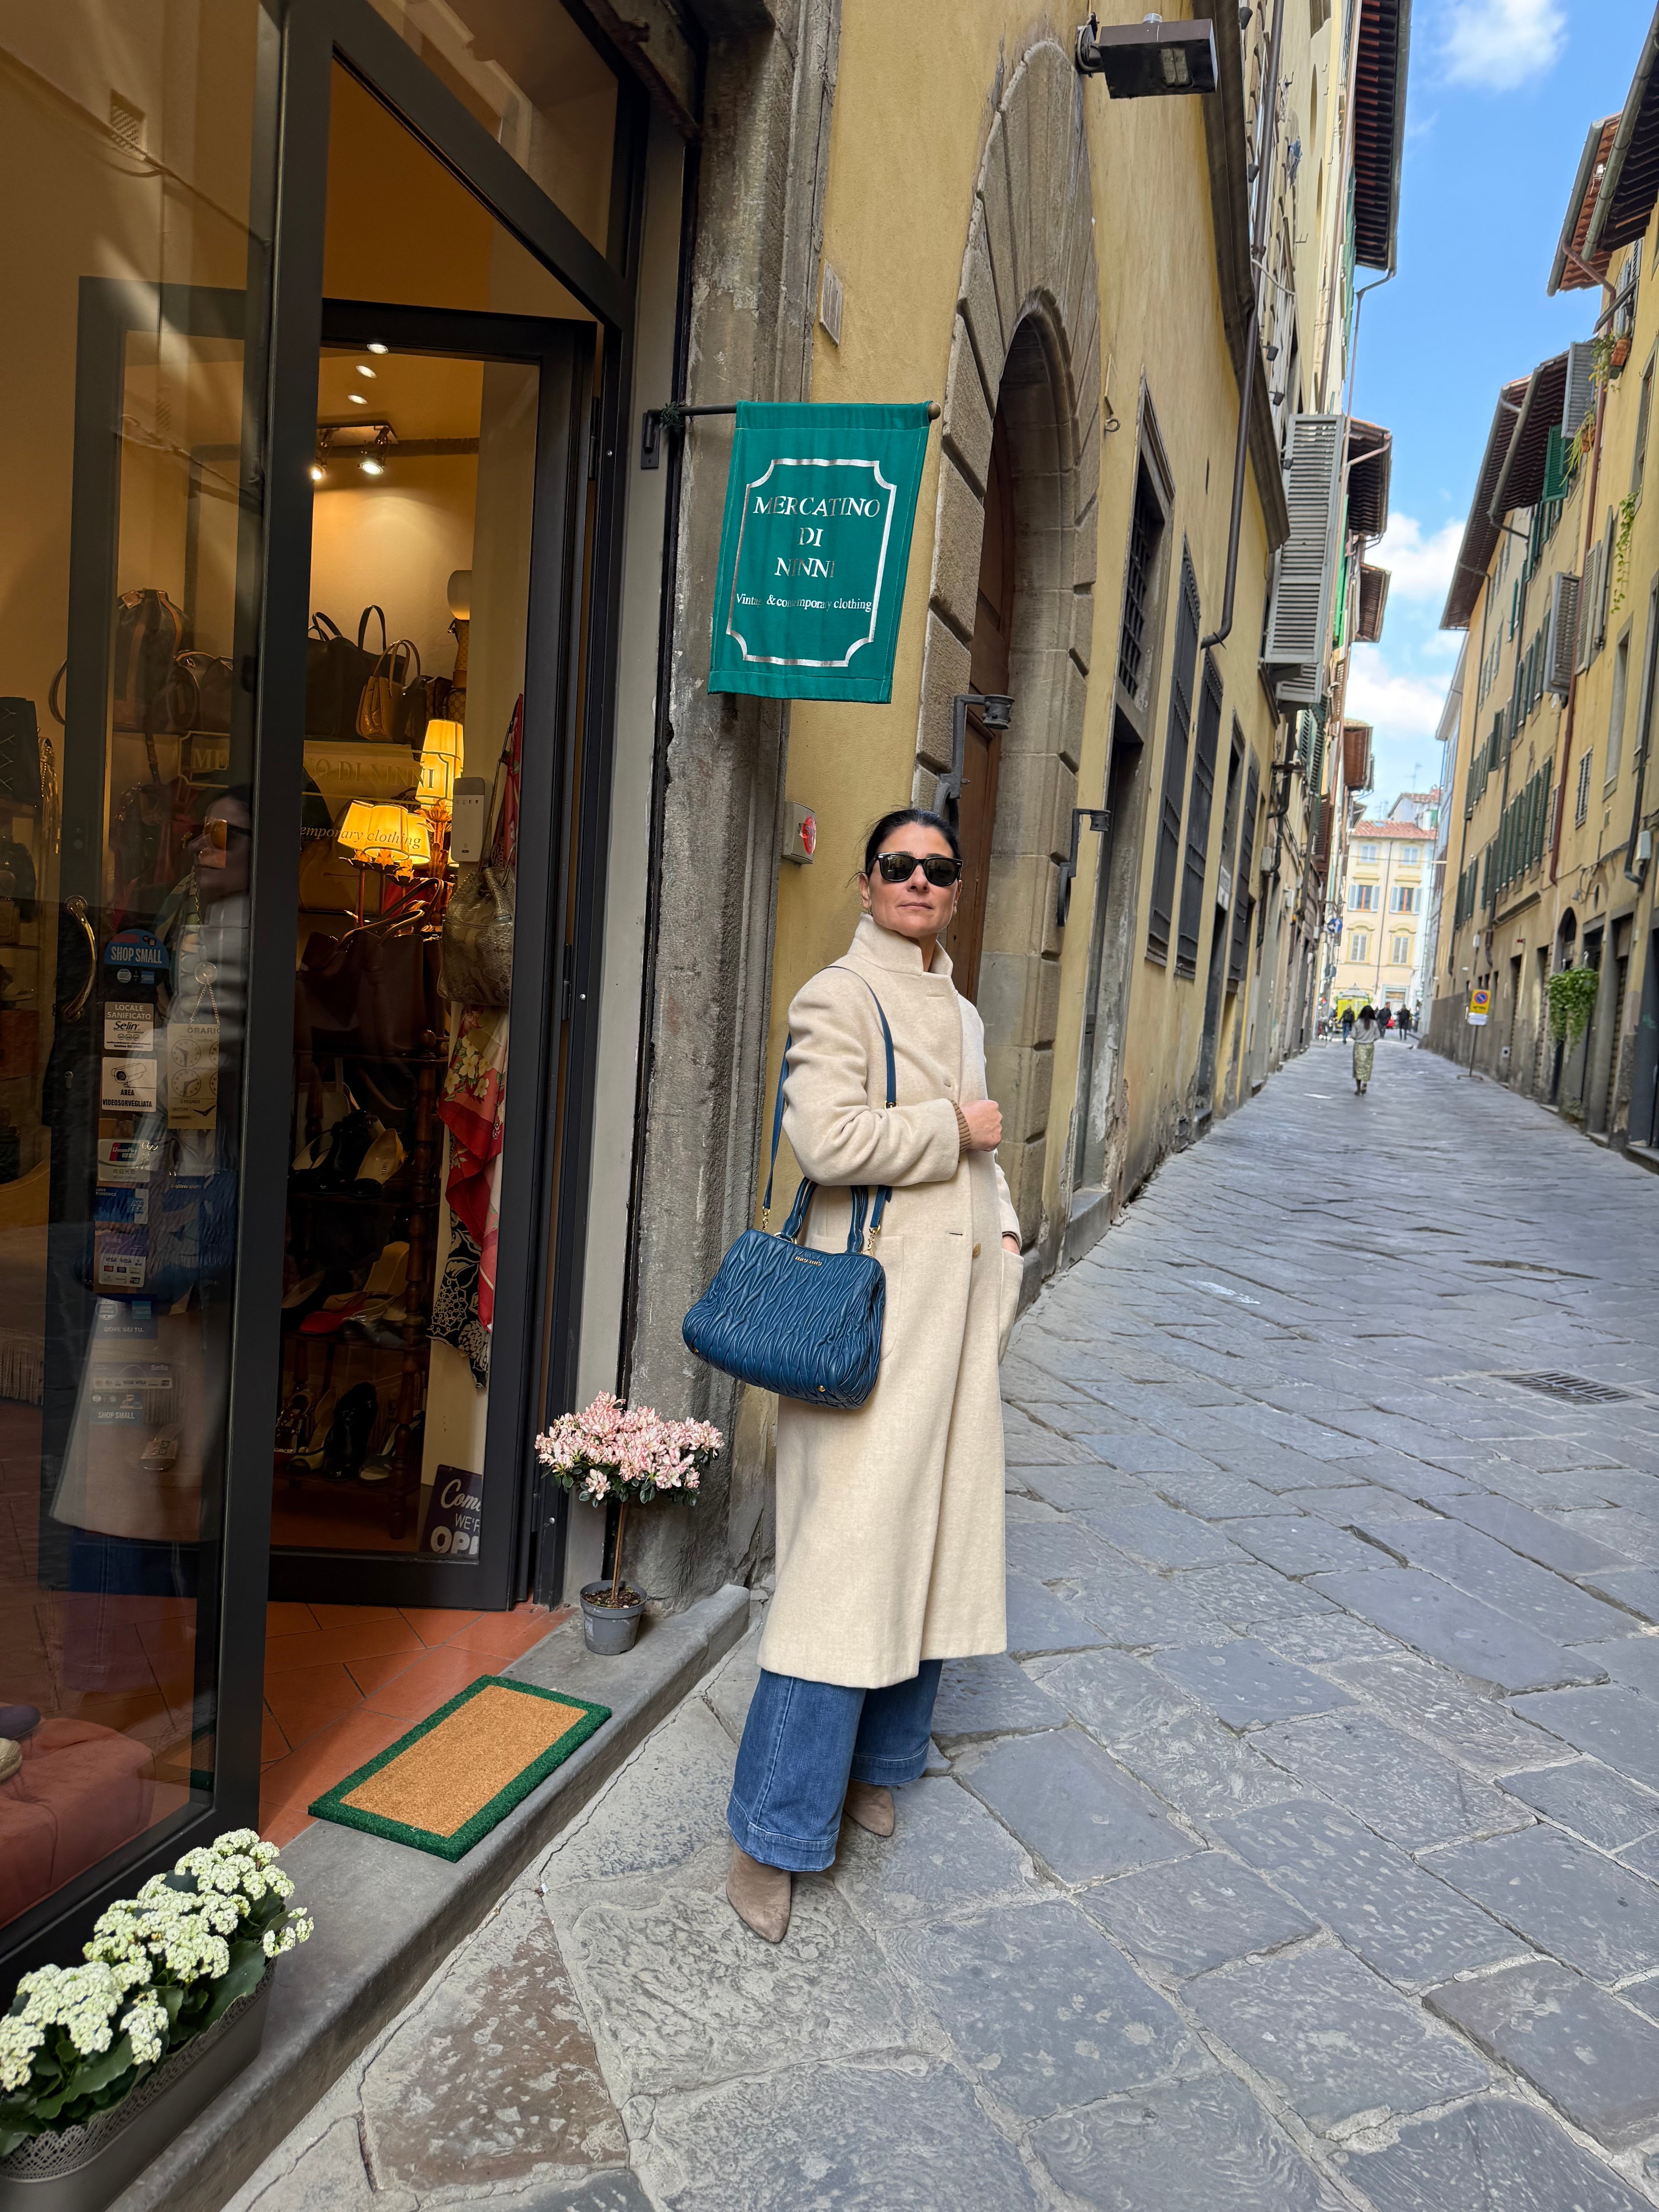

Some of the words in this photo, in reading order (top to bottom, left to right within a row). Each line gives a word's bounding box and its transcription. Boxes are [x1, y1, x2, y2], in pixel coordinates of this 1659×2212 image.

[753, 496, 880, 517] MERCATINO
[798, 528, 824, 547] DI
[775, 557, 836, 578] NINNI
[737, 594, 763, 608] Vintag
[834, 598, 872, 613] clothing
[339, 761, 362, 782] DI
[370, 764, 435, 788] NINNI
[367, 830, 421, 849] clothing
[111, 946, 133, 961] SHOP
[135, 948, 162, 963] SMALL
[113, 1021, 138, 1030] Selin
[102, 1099, 153, 1107] VIDEOSORVEGLIATA
